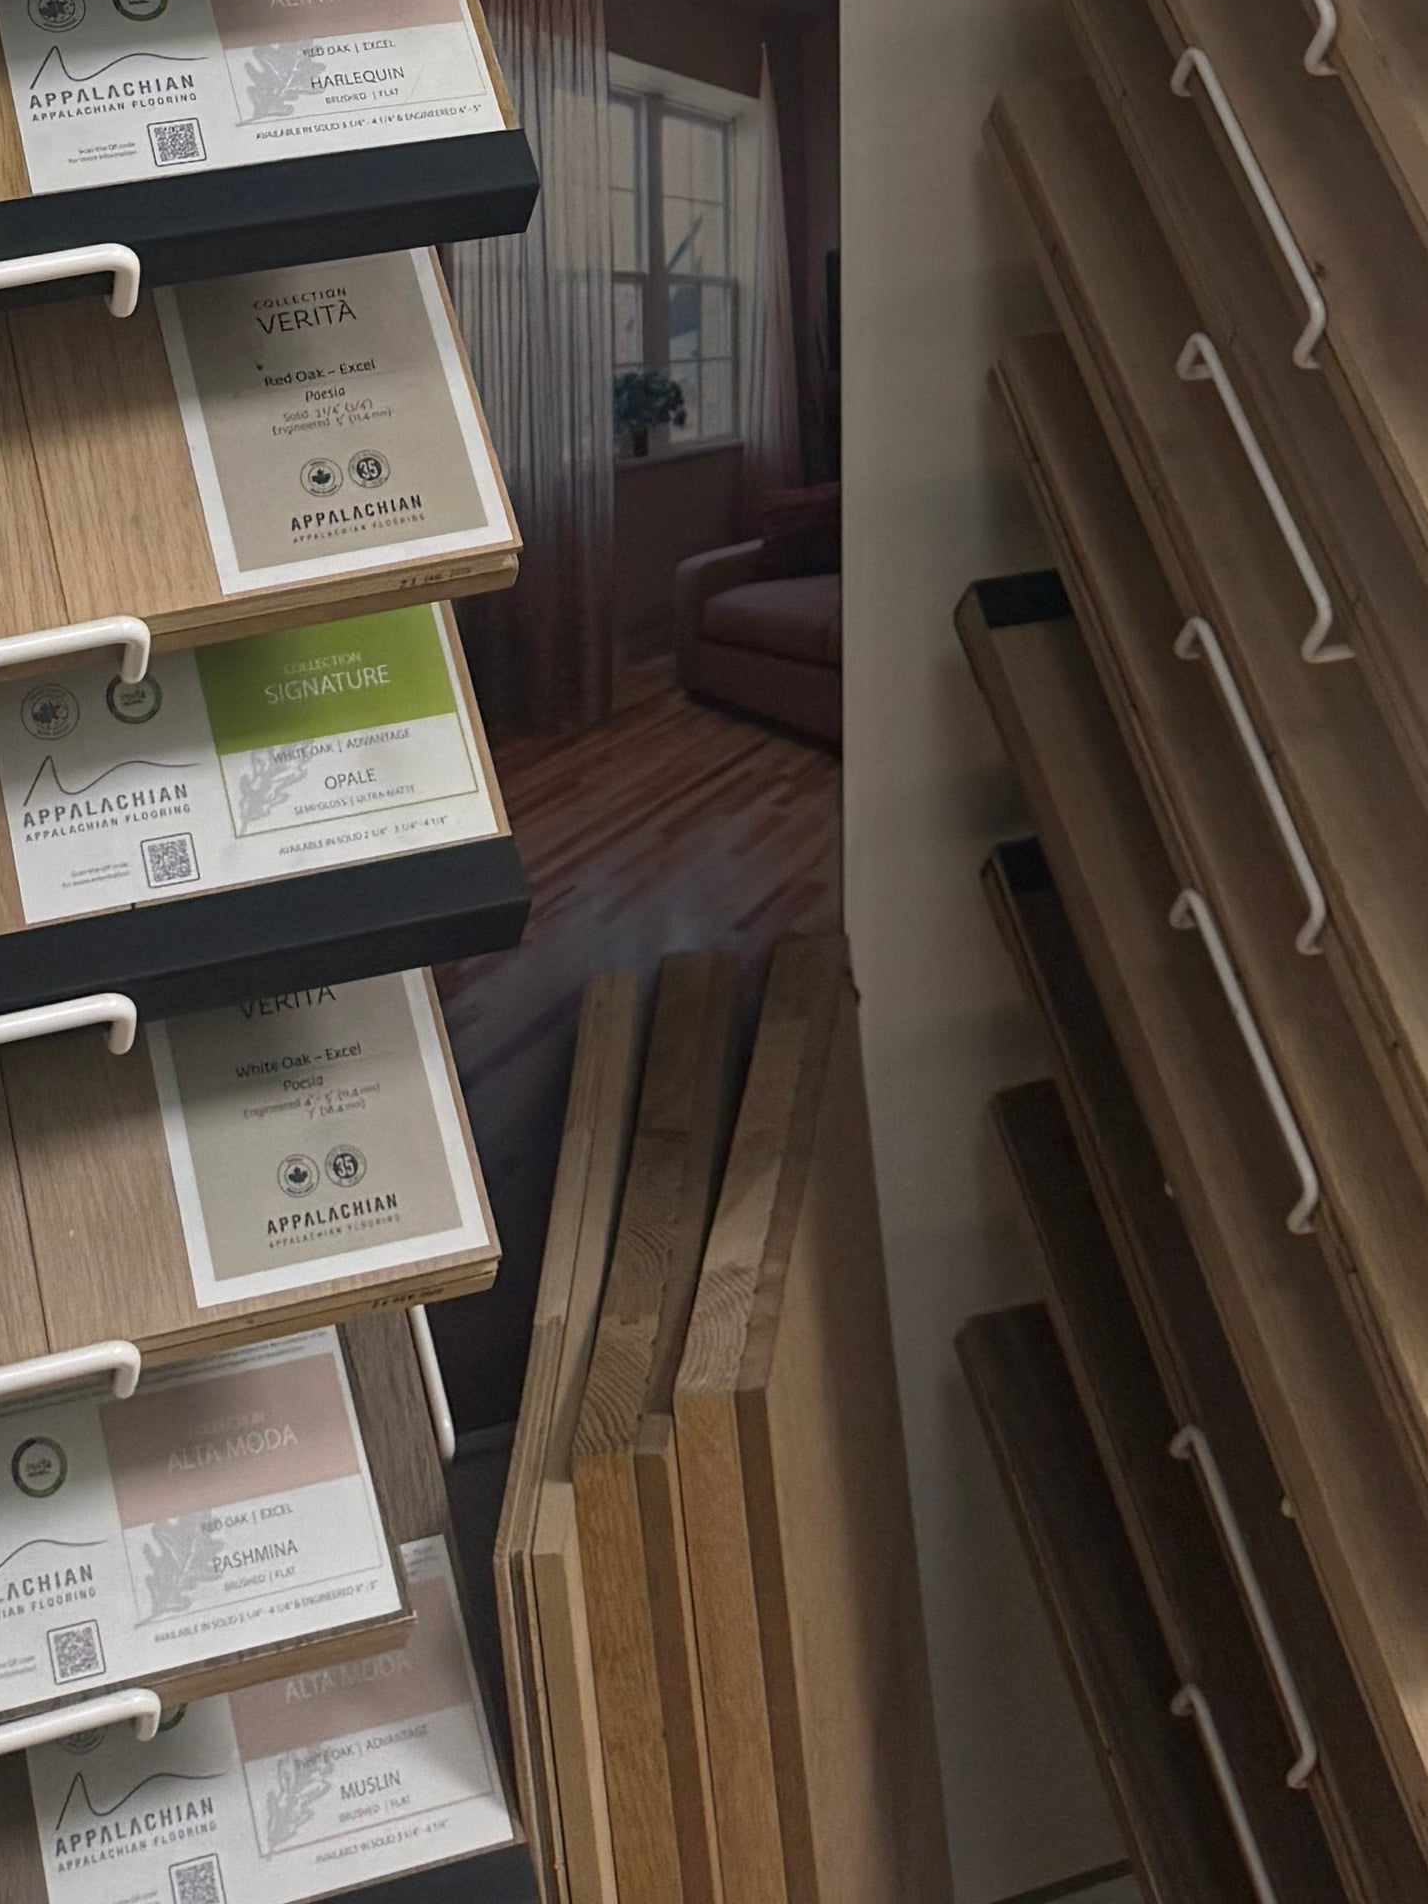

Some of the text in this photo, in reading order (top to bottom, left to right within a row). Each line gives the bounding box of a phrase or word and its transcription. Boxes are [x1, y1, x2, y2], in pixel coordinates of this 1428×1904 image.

[327, 44, 350, 55] OAK
[364, 40, 396, 50] EXCEL
[30, 75, 194, 109] APPALACHIAN
[311, 67, 405, 89] HARLEQUIN
[32, 93, 197, 122] APPALACHIAN FLOORING
[254, 287, 346, 310] COLLECTION
[256, 300, 357, 334] VERITÀ
[265, 358, 375, 386] Red Oak Excel
[305, 387, 345, 402] Poesia
[361, 458, 377, 479] 35
[291, 495, 423, 532] APPALACHIAN
[284, 652, 361, 674] COLLECTION
[265, 664, 391, 704] SIGNATURE
[273, 728, 411, 763] WHITE OAK ADVANTAGE
[324, 768, 377, 790] OPALE
[23, 784, 188, 828] APPALACHIAN
[25, 804, 191, 843] APPALACHIAN FLOORING
[235, 1042, 361, 1078] White Oak Excel
[283, 1075, 323, 1091] Poesia
[336, 1154, 356, 1177] 35
[267, 1193, 398, 1235] APPALACHIAN
[168, 1424, 299, 1472] ALTA MODA
[224, 1514, 248, 1529] OAK
[260, 1503, 294, 1521] EXCEL
[212, 1539, 299, 1573] PASHMINA
[31, 1587, 96, 1611] FLOORING
[285, 1673, 332, 1704] ALTA
[331, 1746, 355, 1762] OAK
[366, 1723, 428, 1751] ADVANTAGE
[340, 1770, 401, 1800] MUSLIN
[55, 1797, 214, 1857] APPALACHIAN
[57, 1820, 217, 1873] APPALACHIAN FLOORING
